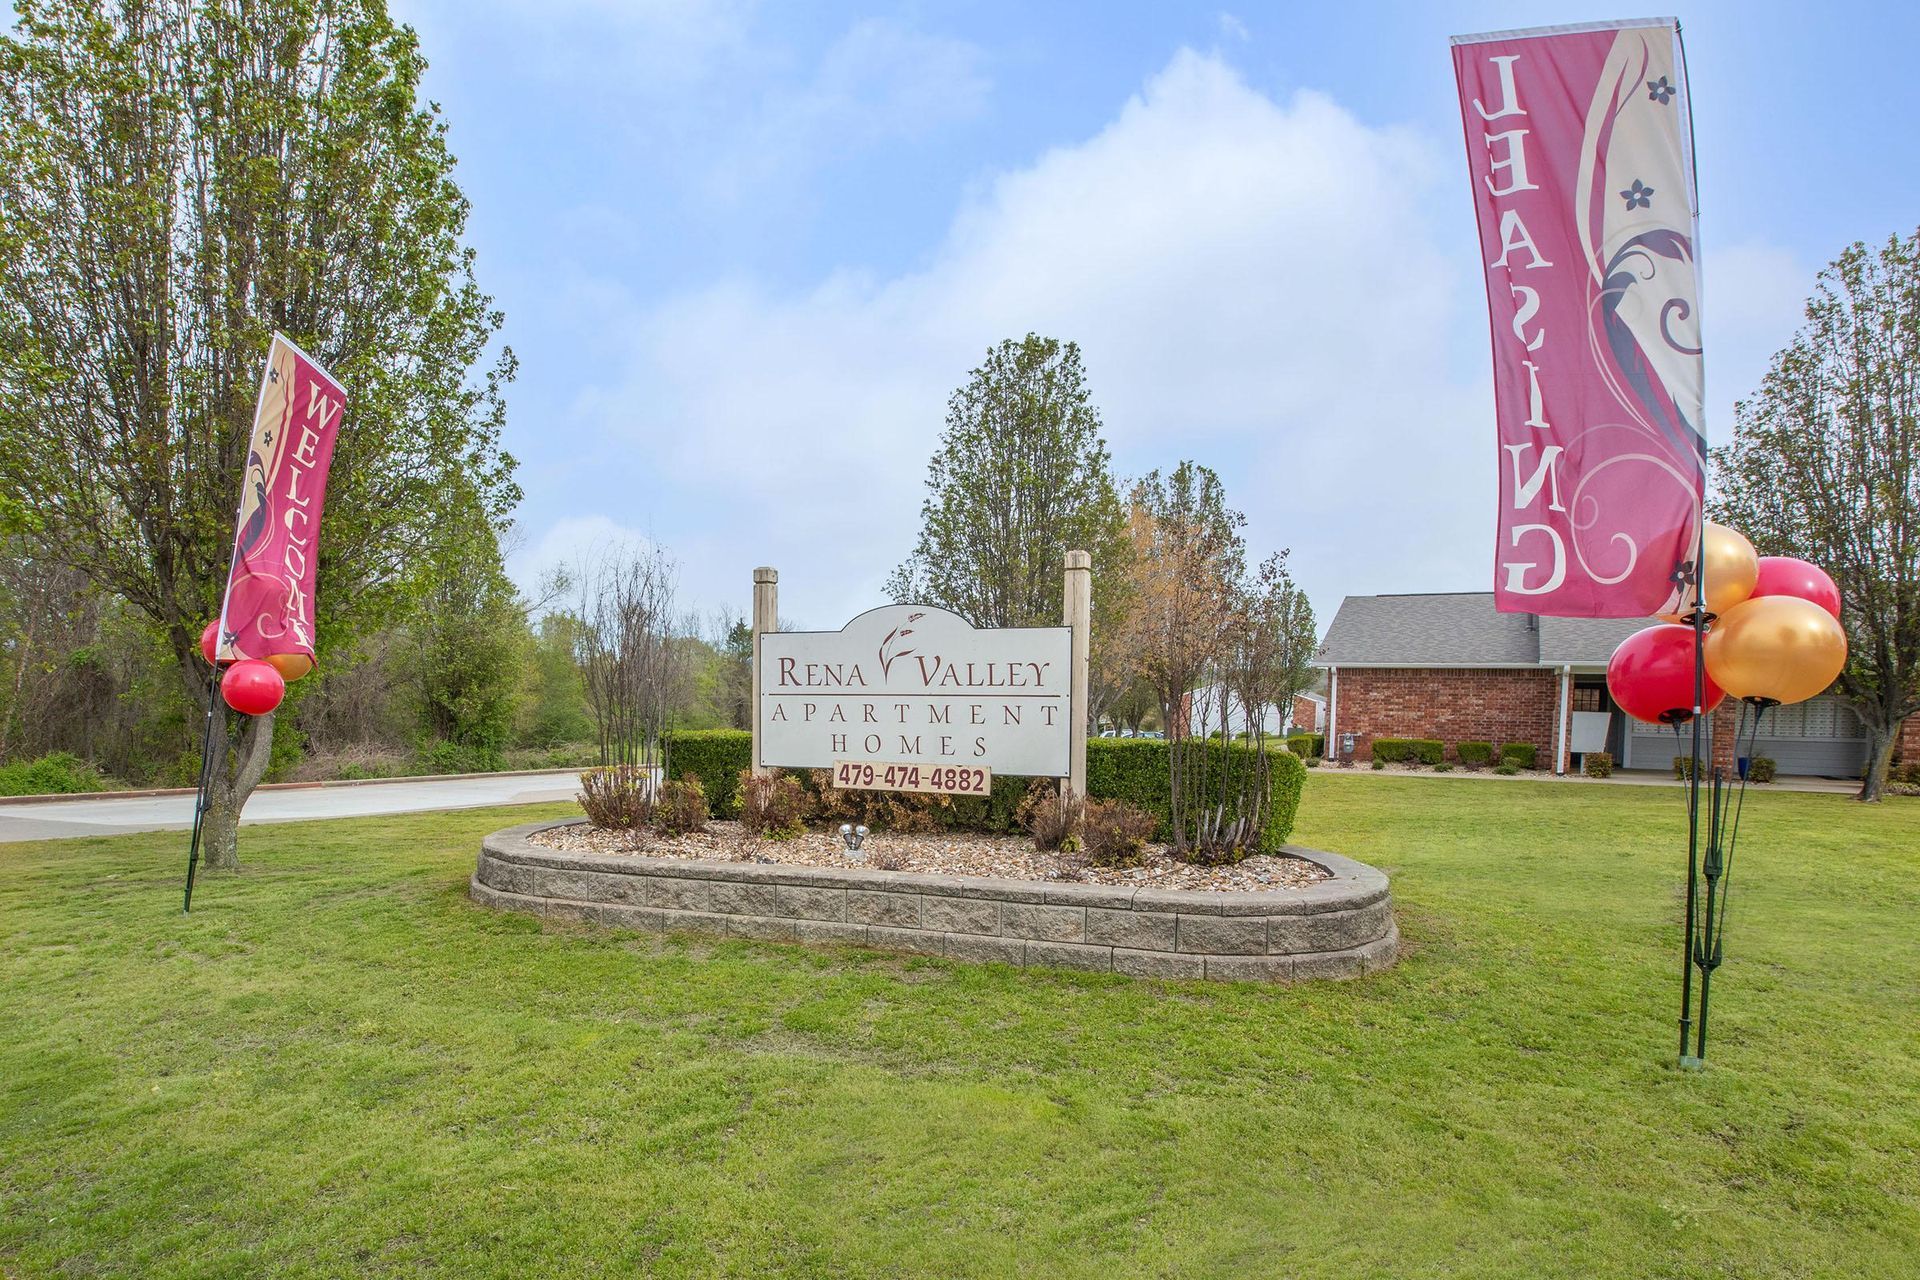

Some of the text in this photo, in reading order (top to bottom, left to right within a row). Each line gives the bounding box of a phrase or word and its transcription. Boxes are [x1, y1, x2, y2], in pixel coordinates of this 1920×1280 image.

[778, 655, 1050, 687] RENA VALLEY
[771, 703, 1058, 726] APARTMENT
[831, 734, 986, 757] HOMES
[838, 764, 985, 792] 479-474-4882
